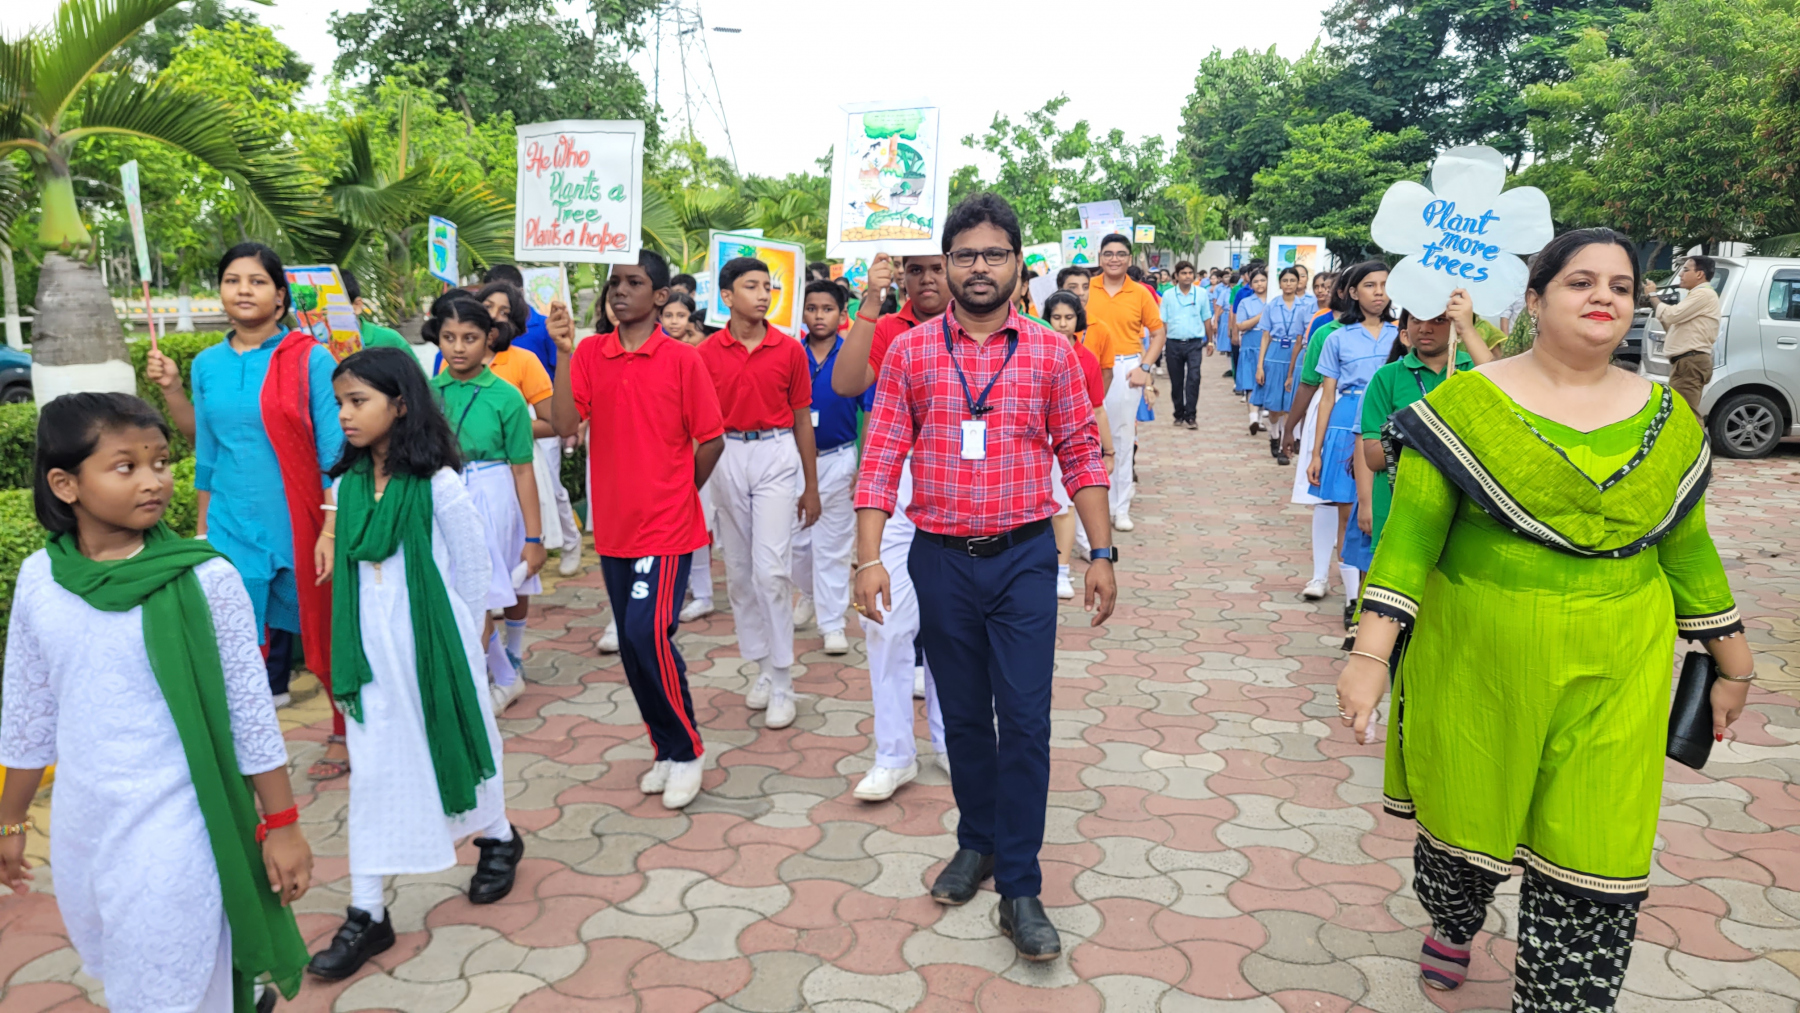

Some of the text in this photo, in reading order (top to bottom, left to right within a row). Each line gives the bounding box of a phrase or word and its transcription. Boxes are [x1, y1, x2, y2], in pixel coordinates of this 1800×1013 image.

[526, 134, 590, 178] He Who
[550, 170, 626, 201] Plants a
[552, 199, 601, 223] Tree
[1422, 200, 1500, 235] Plant
[526, 217, 627, 253] Plants a hope
[1438, 231, 1500, 261] more
[1418, 242, 1489, 282] trees
[631, 580, 650, 600] S
